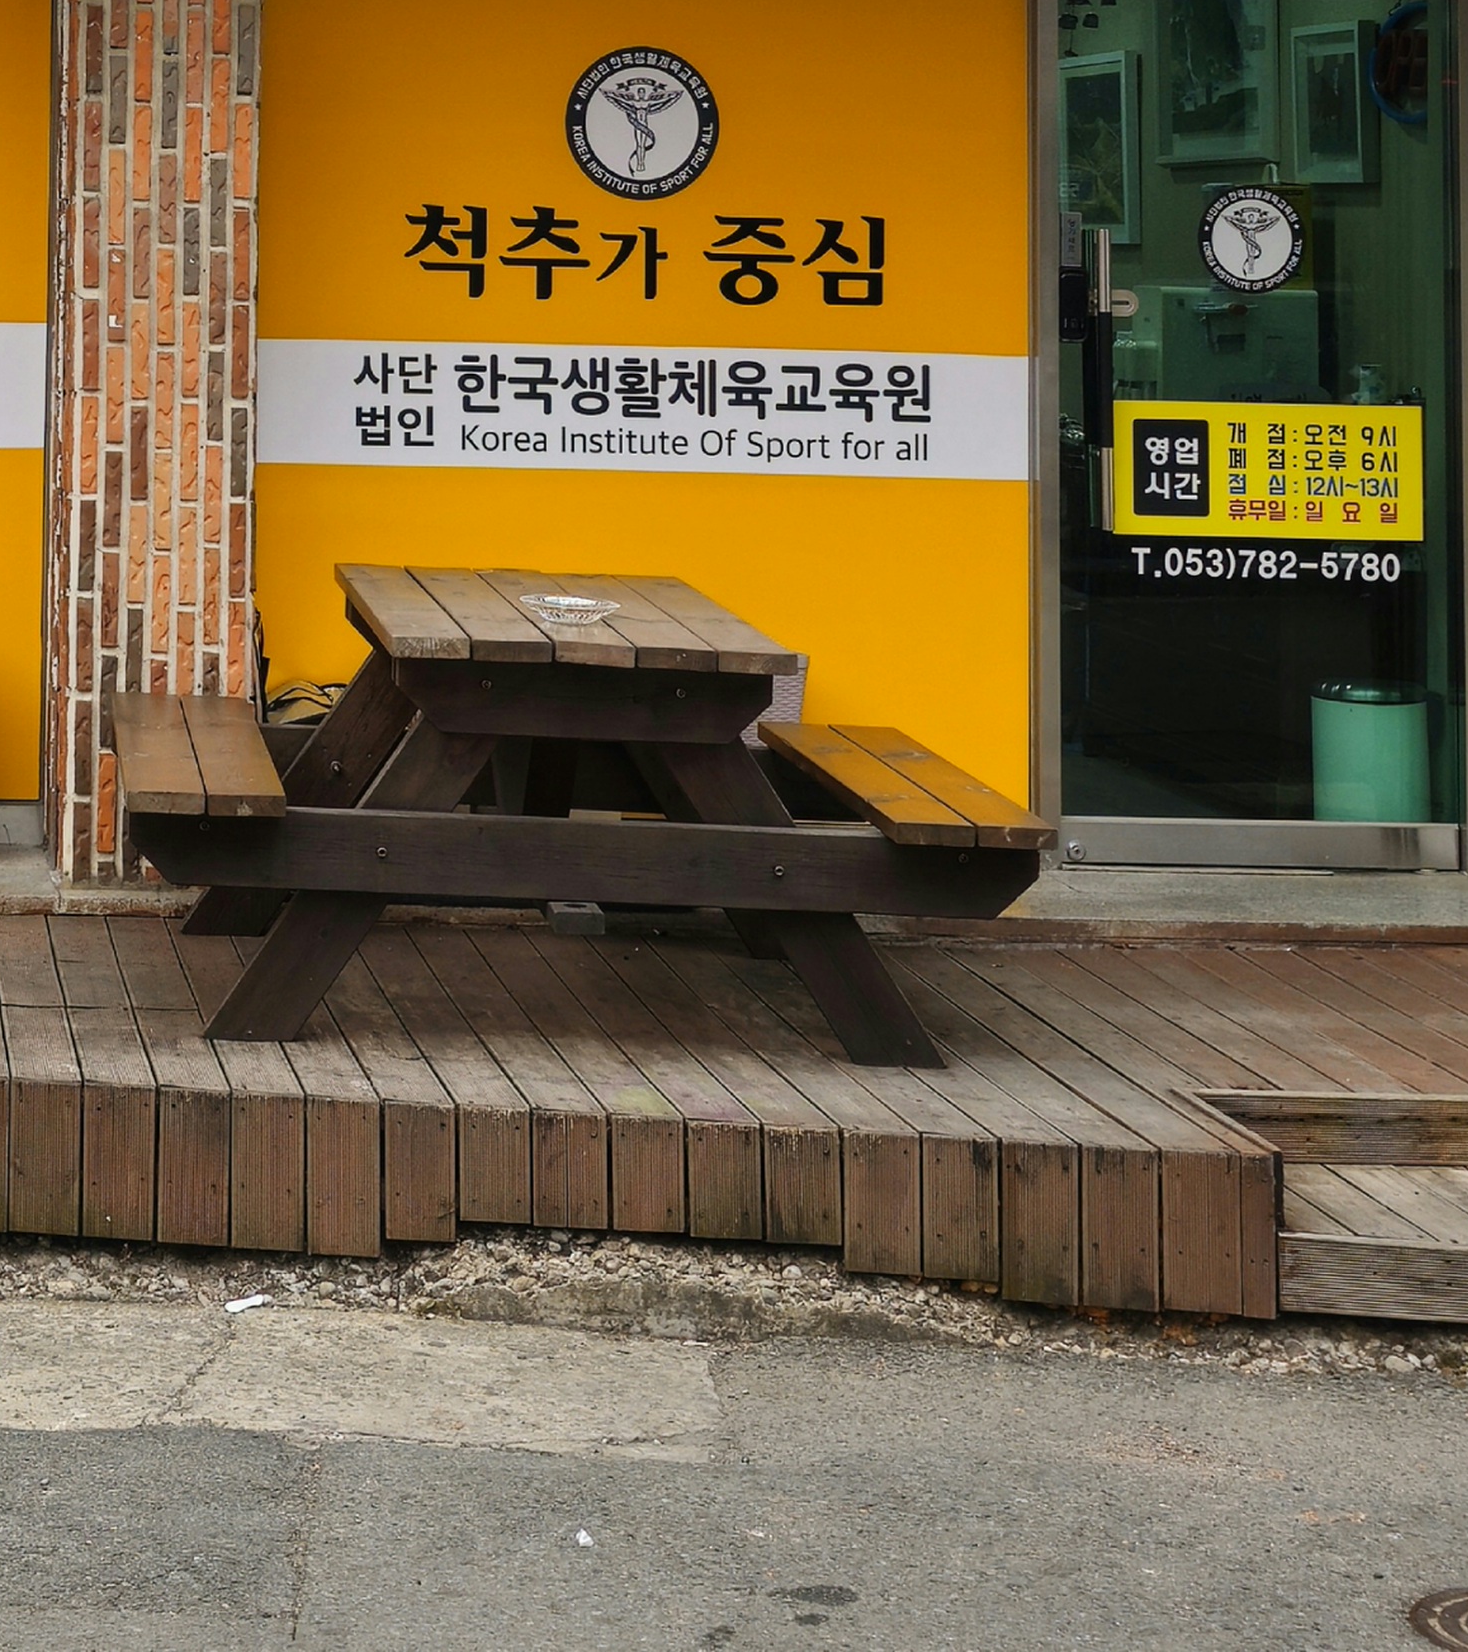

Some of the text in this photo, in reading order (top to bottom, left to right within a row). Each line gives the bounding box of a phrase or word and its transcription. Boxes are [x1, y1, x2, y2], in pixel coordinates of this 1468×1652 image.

[572, 123, 713, 194] KOREA INSTITUTE OF SPORT FOR ALL
[404, 204, 885, 306] 척추가 중심
[354, 353, 932, 423] 사단 한국생활체육교육원
[356, 405, 435, 447] 법인
[461, 424, 928, 463] Korea Institute Of Sport for all
[1361, 426, 1397, 447] 9시
[1145, 437, 1199, 465] 영업
[1361, 452, 1398, 473] 6시
[1145, 472, 1200, 500] 시간
[1131, 547, 1401, 583] T.053)782-5780
